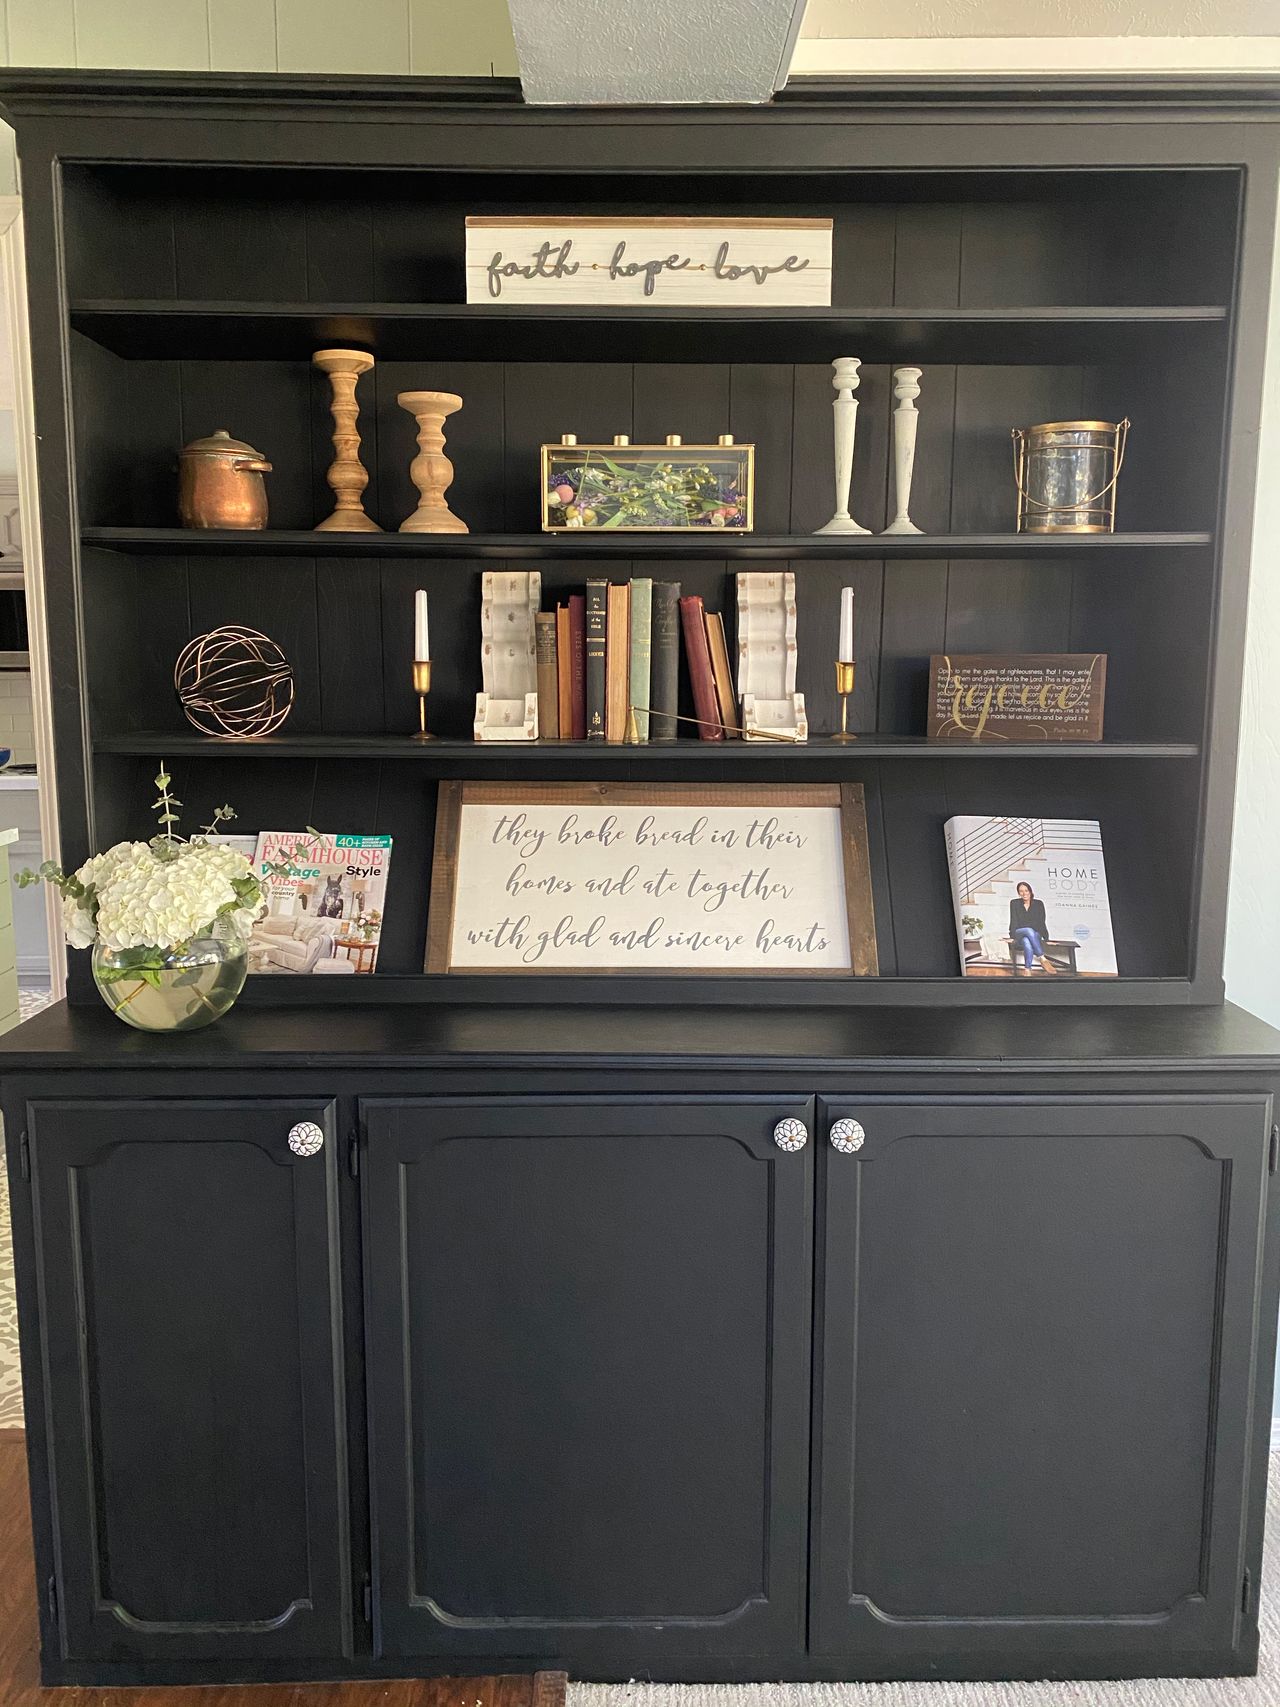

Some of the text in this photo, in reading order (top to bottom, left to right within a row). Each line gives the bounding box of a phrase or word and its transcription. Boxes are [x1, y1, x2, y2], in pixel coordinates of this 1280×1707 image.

[487, 239, 810, 297] faith hope love
[1046, 668, 1056, 676] that
[1063, 669, 1075, 677] may
[1024, 714, 1041, 722] rejoice
[1064, 715, 1077, 723] glad
[338, 836, 361, 848] 40+
[492, 813, 808, 858] they broke bread in their
[262, 845, 383, 866] FARMHOUSE
[346, 865, 381, 878] Style
[1048, 867, 1098, 879] HOME
[505, 863, 793, 912] homes and ate together
[1049, 878, 1098, 890] BODY
[467, 915, 831, 963] with glad and sincere hearts
